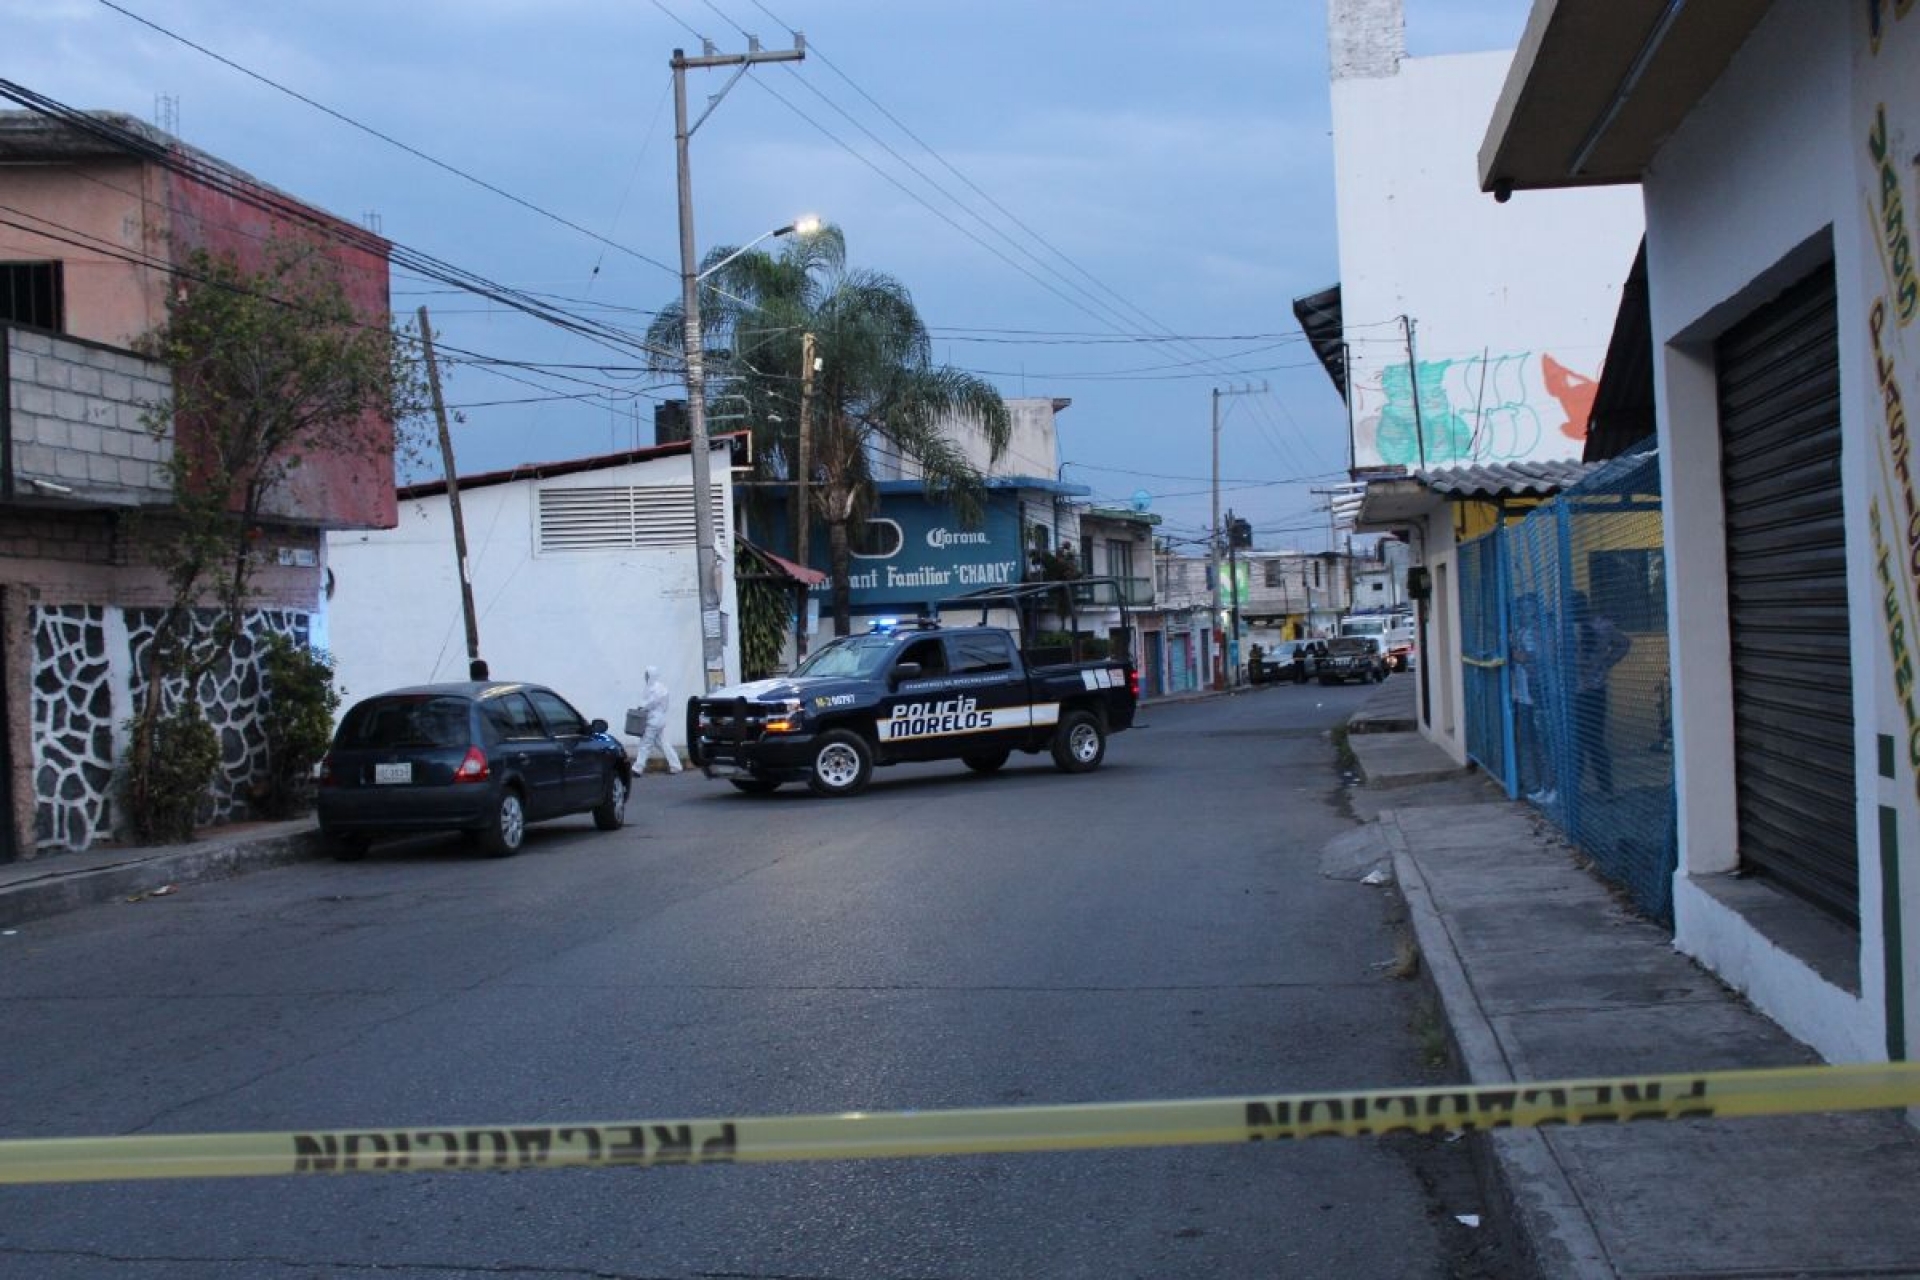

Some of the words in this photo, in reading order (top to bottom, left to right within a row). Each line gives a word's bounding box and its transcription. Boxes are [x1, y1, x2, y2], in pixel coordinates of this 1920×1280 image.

[927, 527, 987, 549] Corona
[887, 565, 951, 588] Familiar
[890, 712, 993, 738] MORELOS
[1244, 1079, 1716, 1142] PRECAUCION
[293, 1122, 738, 1172] PRECAUCION
